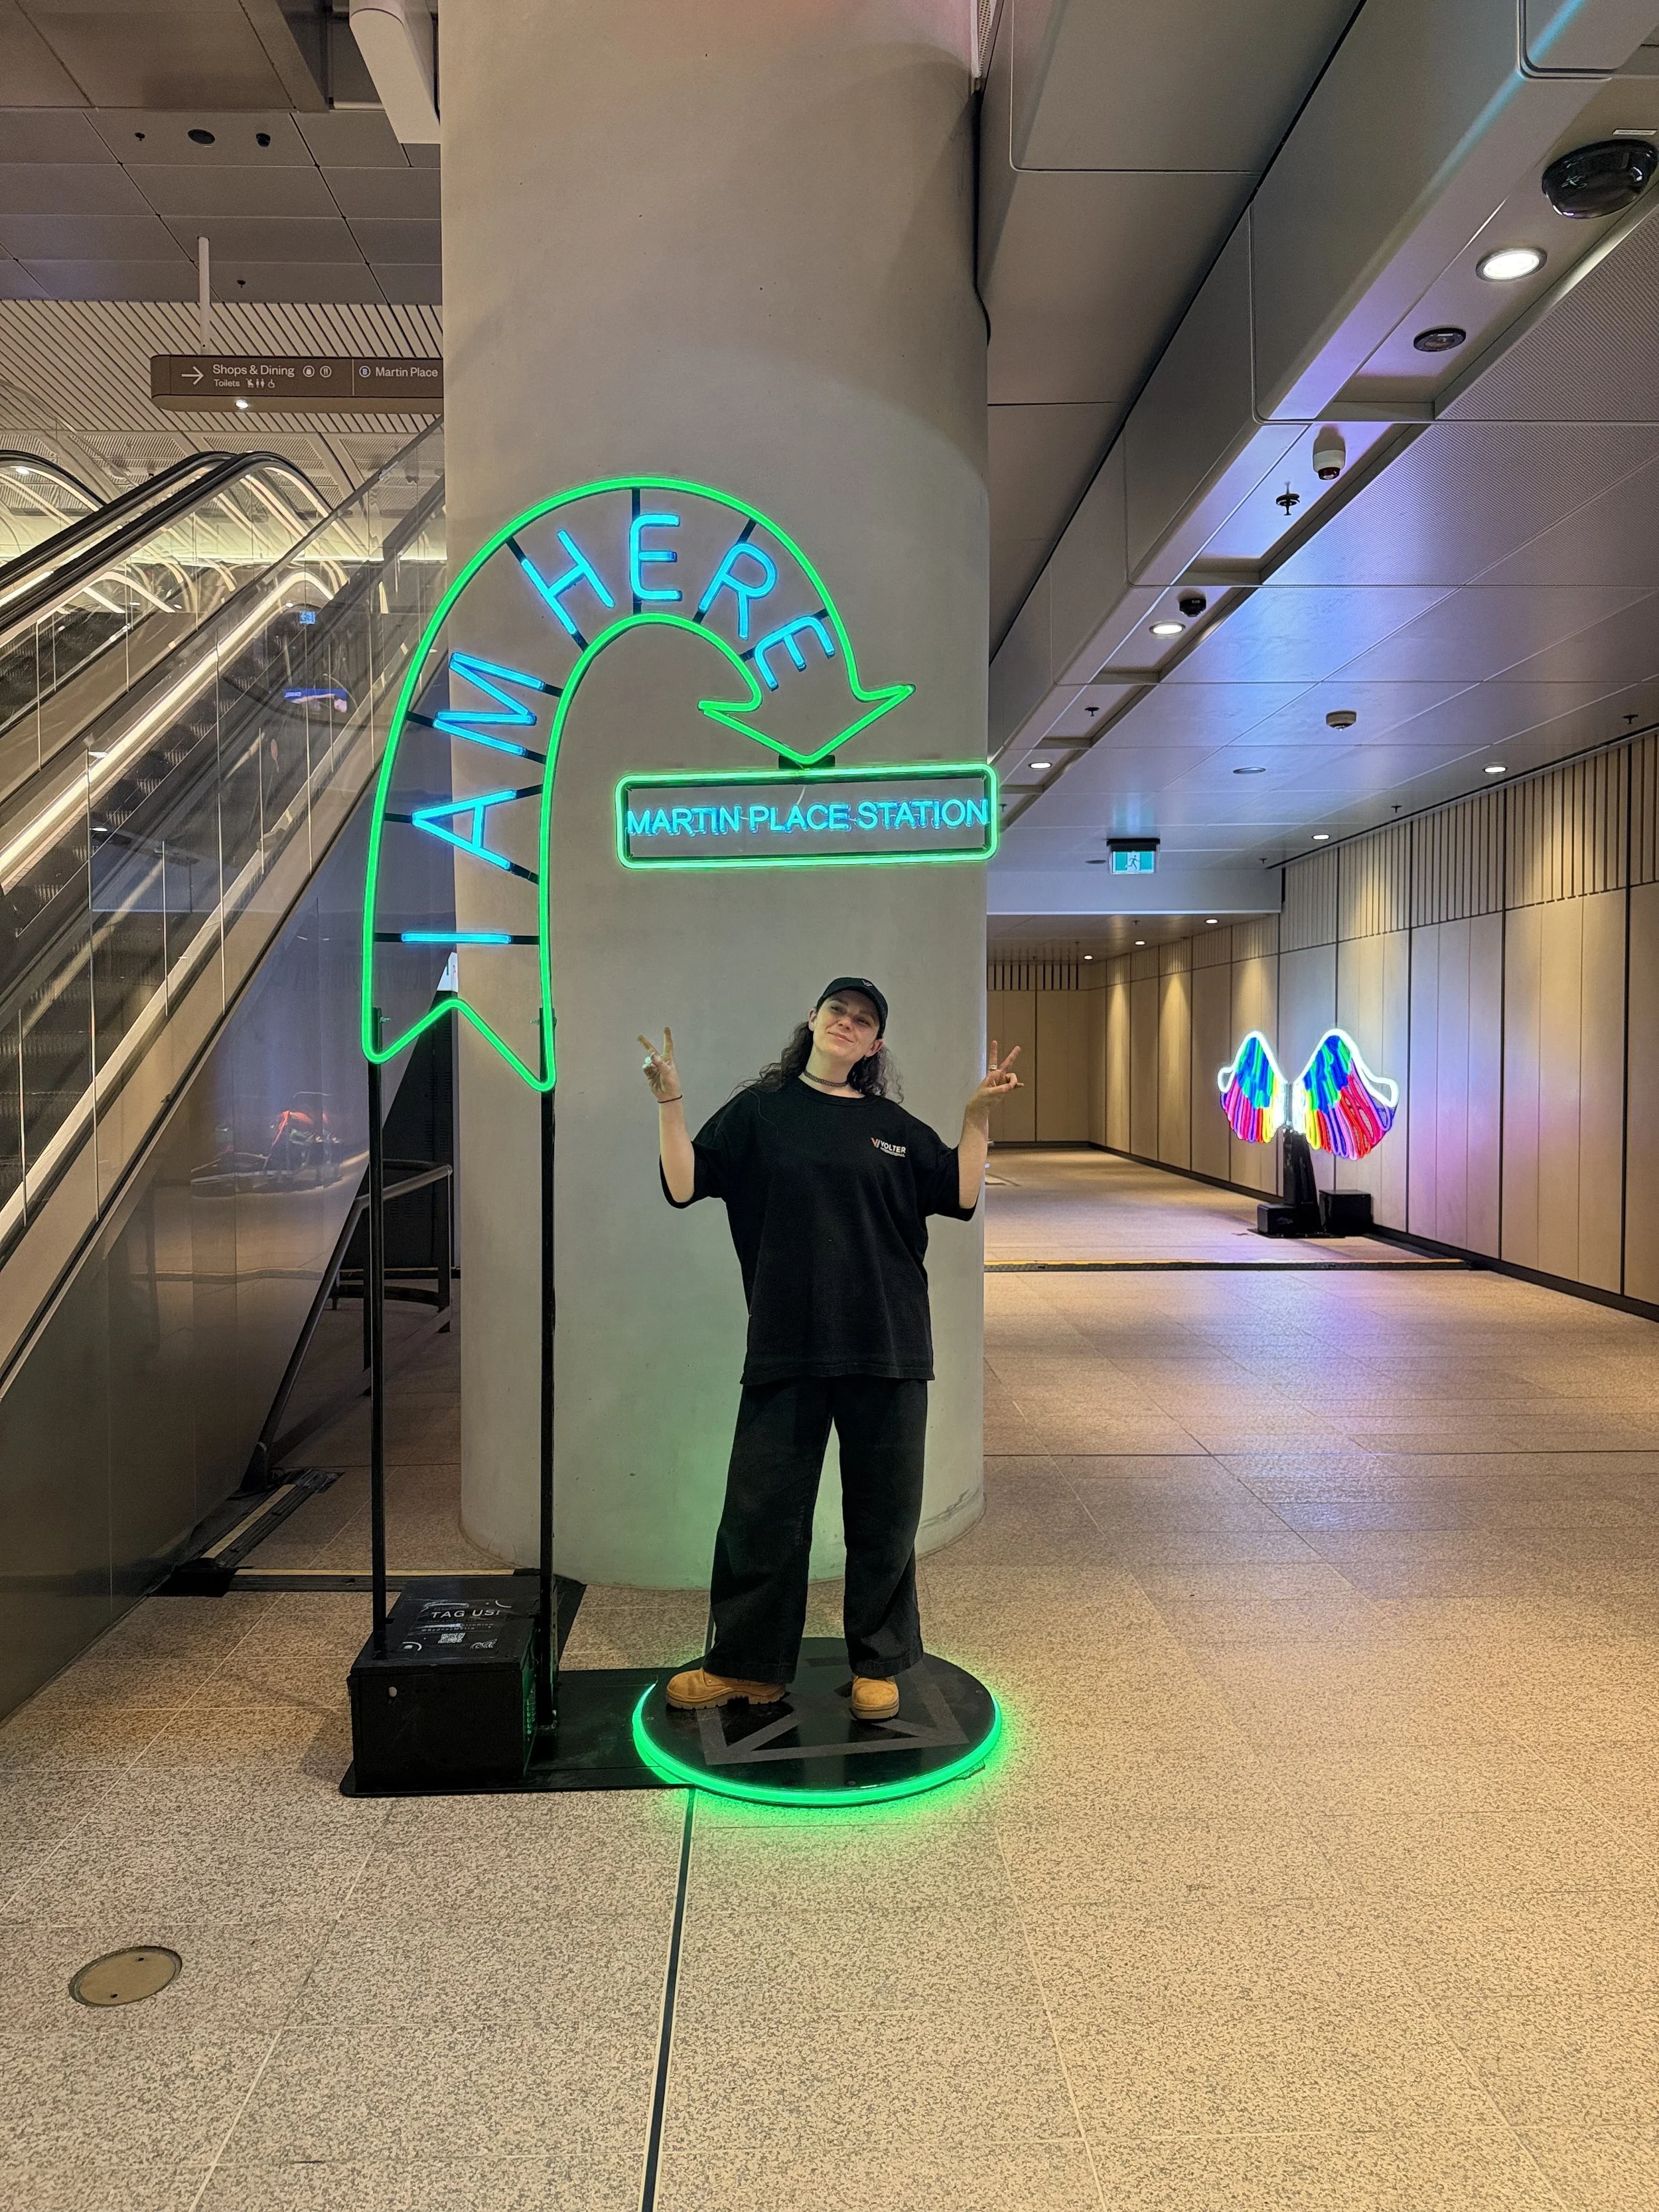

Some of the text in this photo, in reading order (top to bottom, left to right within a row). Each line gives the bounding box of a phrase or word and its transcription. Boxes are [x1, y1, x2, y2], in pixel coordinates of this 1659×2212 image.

[212, 364, 295, 378] Shops & Dining
[375, 366, 409, 377] Martin
[410, 367, 439, 377] Place
[401, 512, 836, 945] I AM HERE
[627, 798, 988, 836] MARTIN PLACE STATION
[881, 1140, 906, 1153] VOLTER
